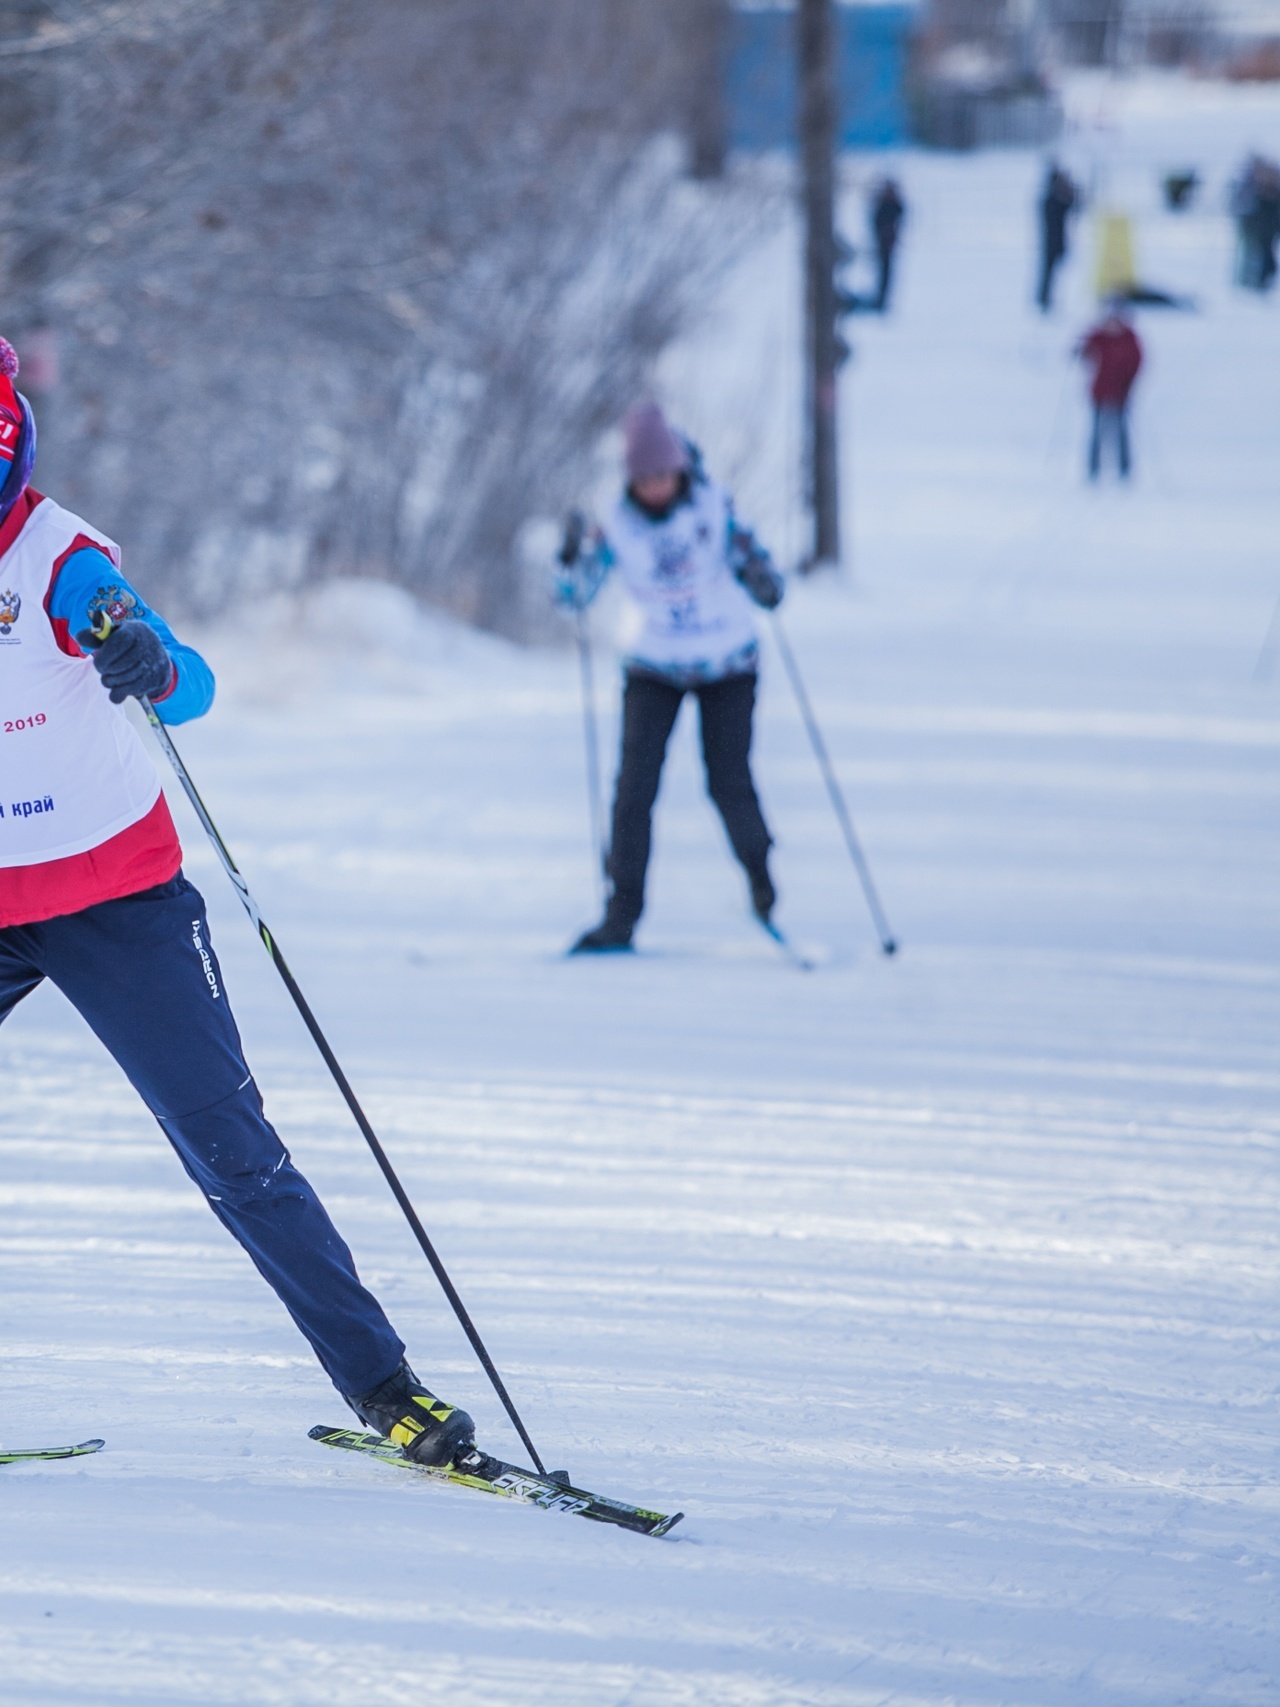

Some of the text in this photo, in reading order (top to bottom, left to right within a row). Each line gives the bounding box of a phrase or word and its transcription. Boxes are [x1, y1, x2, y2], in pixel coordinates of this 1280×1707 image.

[4, 713, 47, 733] 2019
[12, 795, 54, 818] край
[192, 920, 220, 998] NORDSKI
